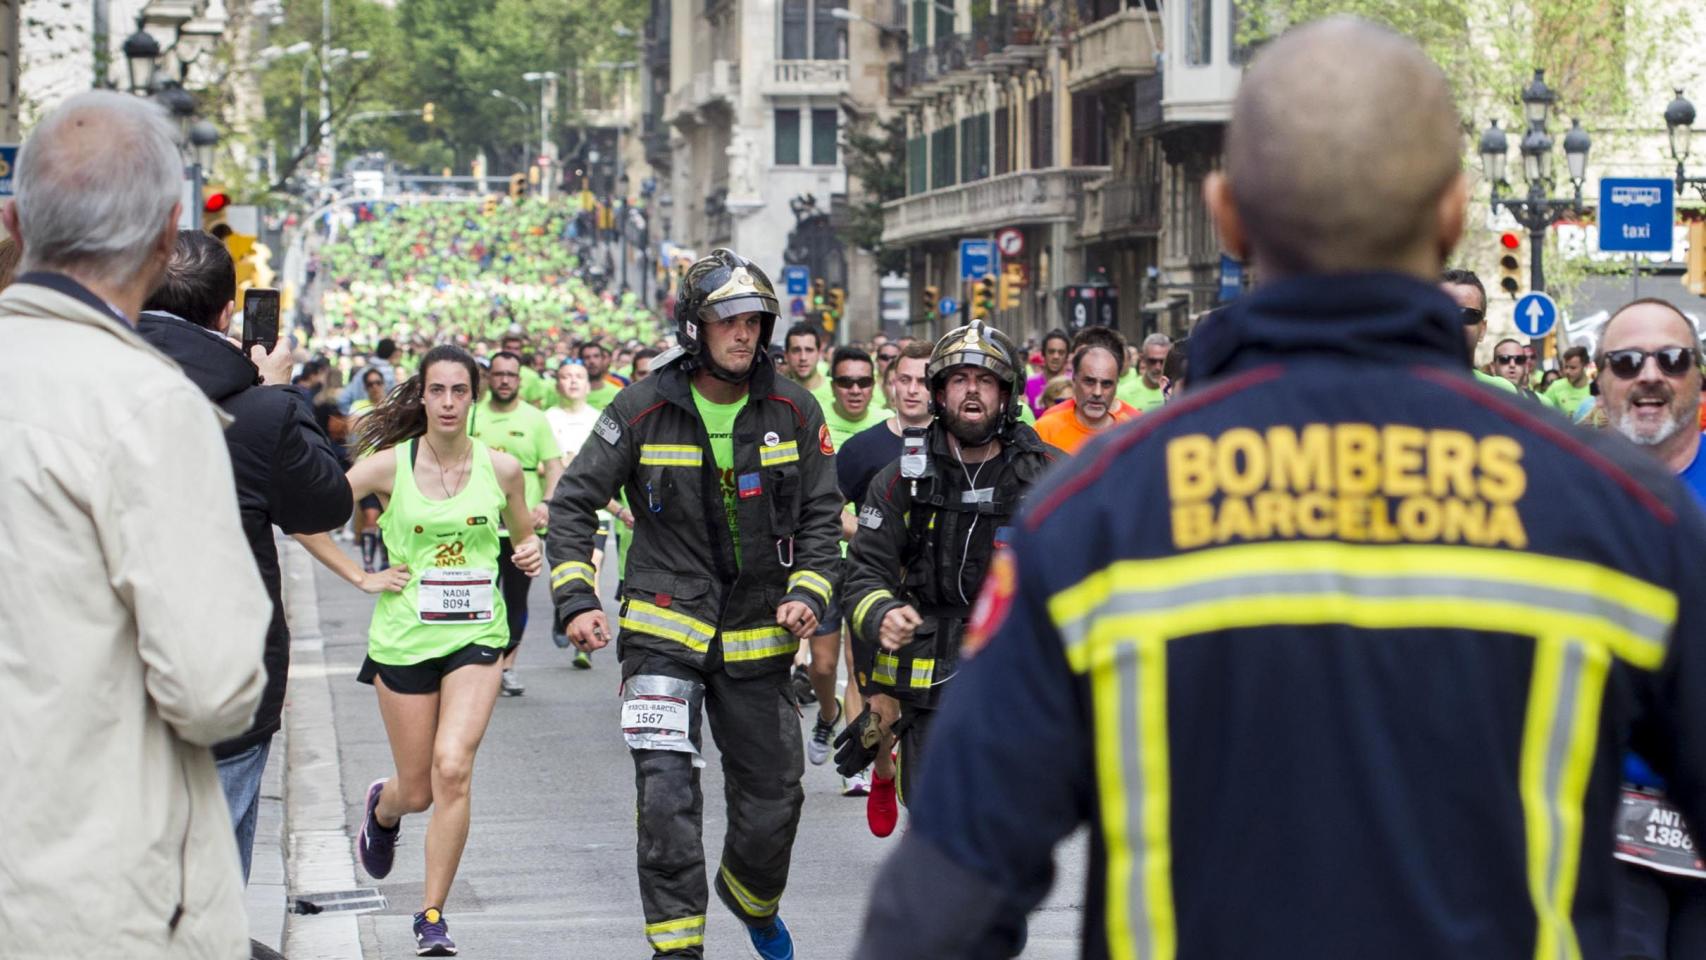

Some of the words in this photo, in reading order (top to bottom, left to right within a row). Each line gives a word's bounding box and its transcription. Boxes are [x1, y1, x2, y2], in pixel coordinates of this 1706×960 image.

[1622, 223, 1651, 238] taxi
[1166, 422, 1528, 505] BOMBERS
[1170, 490, 1530, 550] BARCELONA
[434, 541, 464, 558] 20
[435, 556, 466, 567] ANYS
[442, 589, 470, 597] NADIA
[442, 599, 470, 609] 8094
[636, 713, 663, 724] 1567
[1649, 807, 1687, 828] ANT
